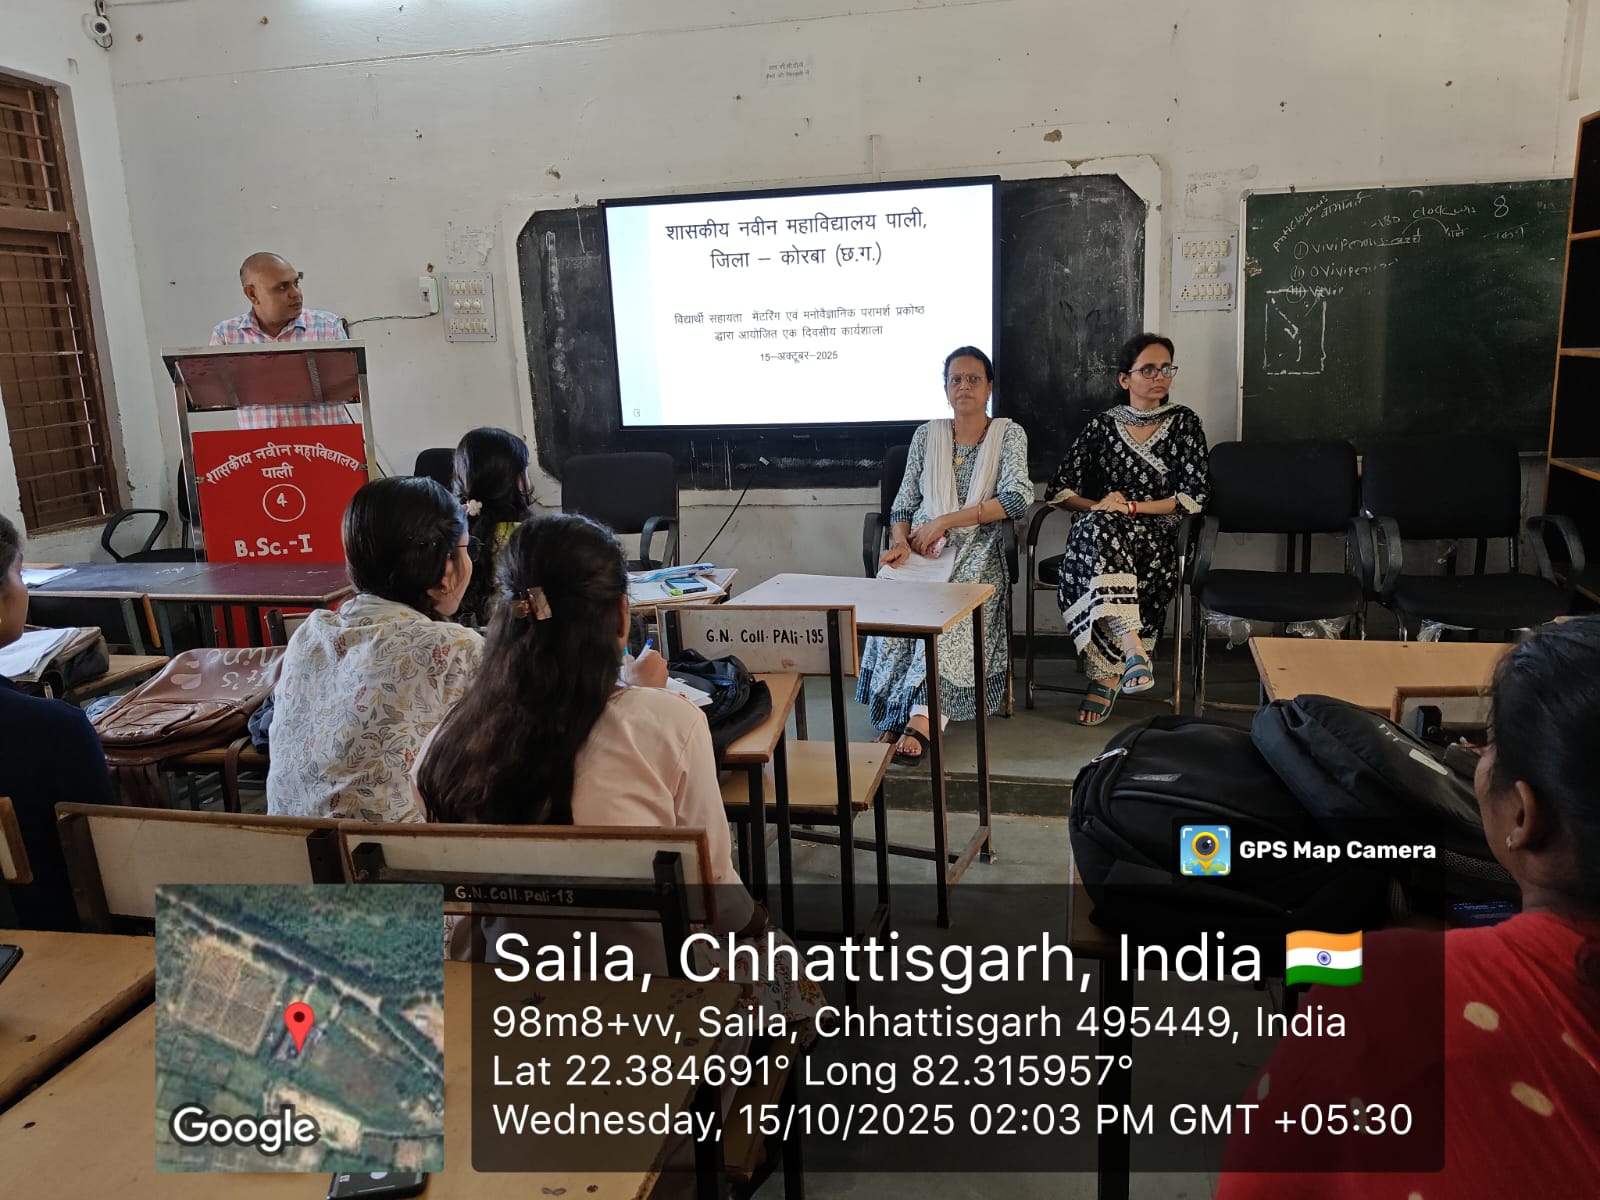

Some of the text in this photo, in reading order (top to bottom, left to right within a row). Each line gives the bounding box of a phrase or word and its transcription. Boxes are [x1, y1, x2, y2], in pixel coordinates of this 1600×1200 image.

[1494, 195, 1509, 218] 8
[665, 206, 927, 241] शासकीय नवीन महाविद्यालय पाली,
[711, 249, 750, 269] जिला
[780, 245, 826, 266] कोरबा
[835, 242, 882, 267] (छ.ग.)
[674, 312, 705, 325] विद्यार्थी
[709, 313, 743, 324] सहायता
[786, 308, 799, 322] एवं
[803, 306, 856, 320] मनोवैज्ञानिक
[860, 303, 891, 318] परामर्श
[896, 303, 926, 317] प्रकोष्ठ
[738, 327, 778, 340] आयोजित
[782, 328, 798, 339] एक
[802, 325, 837, 338] दिवसीय
[841, 323, 883, 337] कार्यशाला
[206, 441, 361, 485] शासकीय नवीन महाविद्यालय
[261, 462, 295, 480] पाली
[276, 492, 289, 508] 4
[234, 533, 313, 558] B.Sc.-I
[706, 628, 733, 643] G.N.
